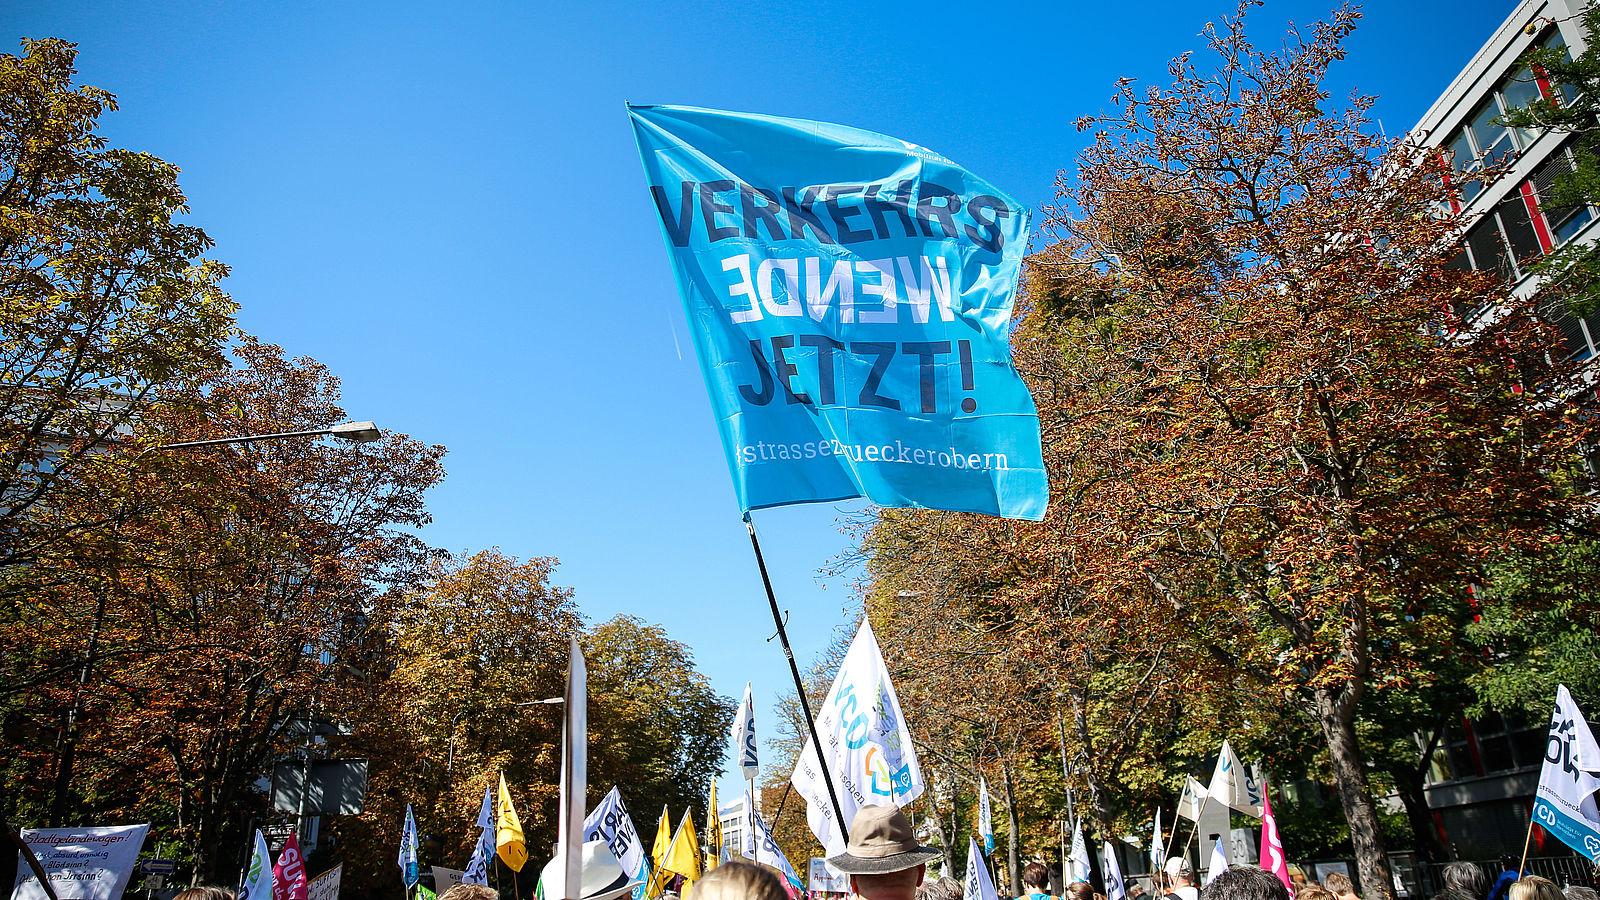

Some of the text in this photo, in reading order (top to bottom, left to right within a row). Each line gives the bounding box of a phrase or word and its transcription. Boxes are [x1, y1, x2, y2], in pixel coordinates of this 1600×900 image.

[650, 179, 1010, 255] VERKEHRS
[738, 334, 978, 414] JETZT!
[25, 830, 133, 847] Stadtgeländewagen!
